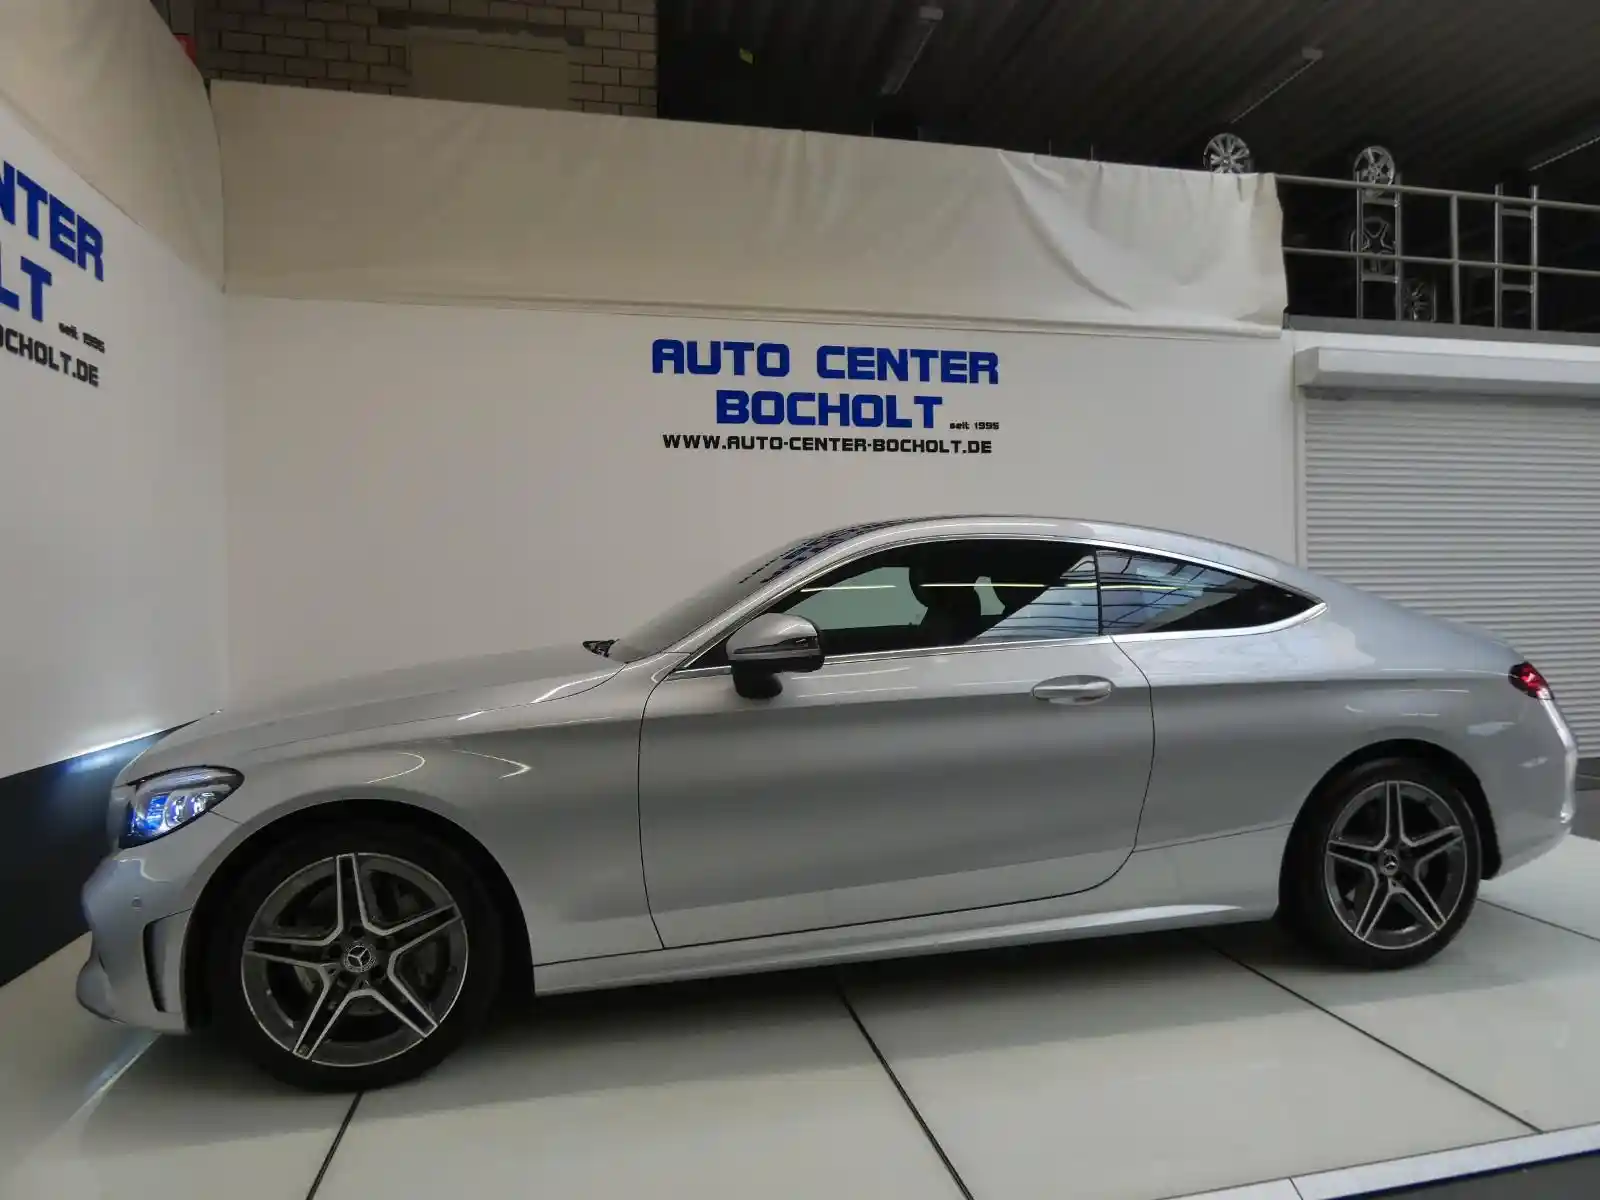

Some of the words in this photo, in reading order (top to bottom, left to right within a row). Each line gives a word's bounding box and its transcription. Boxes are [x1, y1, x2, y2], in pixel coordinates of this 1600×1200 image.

[0, 324, 99, 388] CHOLT.DE
[652, 339, 791, 378] AUTO
[816, 345, 999, 385] CENTER
[716, 389, 943, 429] BOCHOLT
[949, 421, 970, 430] seit
[662, 433, 993, 454] WWW.AUTO-CENTER-BOCHOLT.DE
